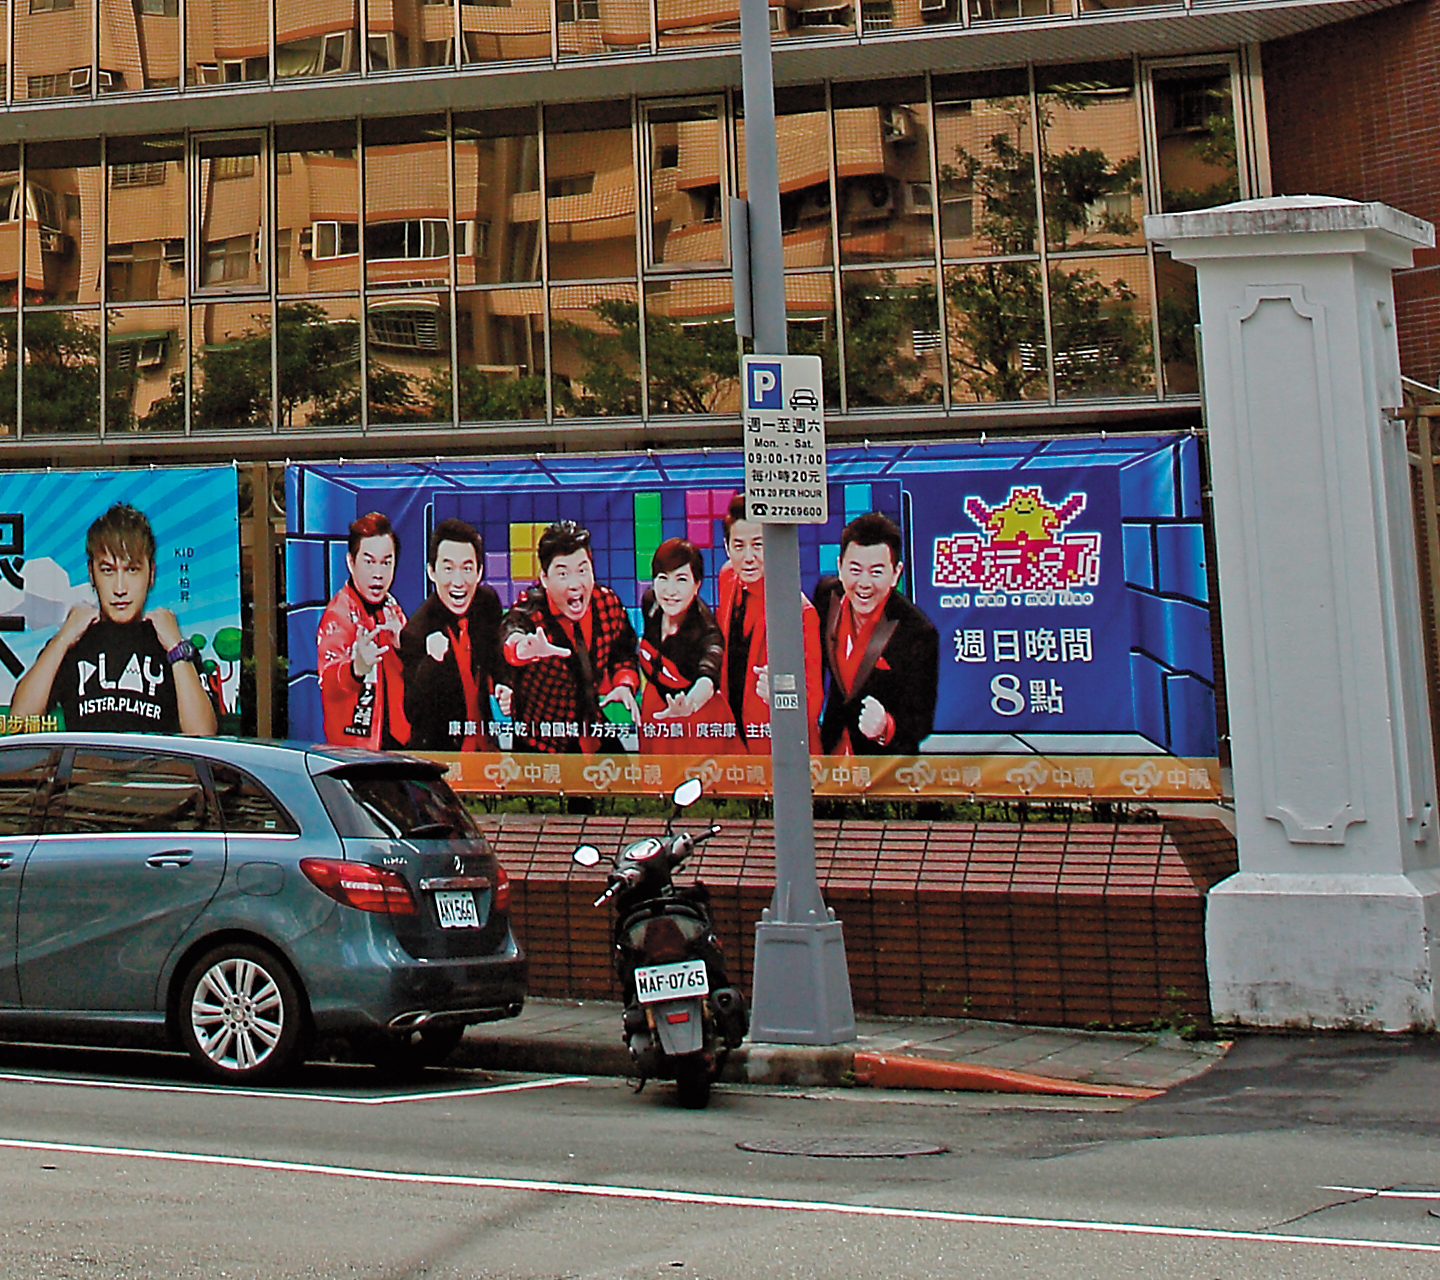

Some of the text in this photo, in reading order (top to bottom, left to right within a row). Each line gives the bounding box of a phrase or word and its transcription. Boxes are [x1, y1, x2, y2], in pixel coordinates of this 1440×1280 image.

[753, 370, 776, 402] P
[747, 416, 821, 433] 週一至週六
[754, 438, 779, 448] Mon.
[794, 438, 814, 449] Sat.
[748, 452, 823, 465] 09:00-17:00
[751, 469, 821, 483] 每小時20元
[779, 488, 796, 498] PER
[798, 489, 823, 499] HOUR
[174, 547, 194, 558] KID
[953, 628, 1093, 662] 週日晚間
[77, 652, 165, 697] PLAY
[990, 673, 1064, 716] 8點
[638, 970, 705, 994] MAF-0765
